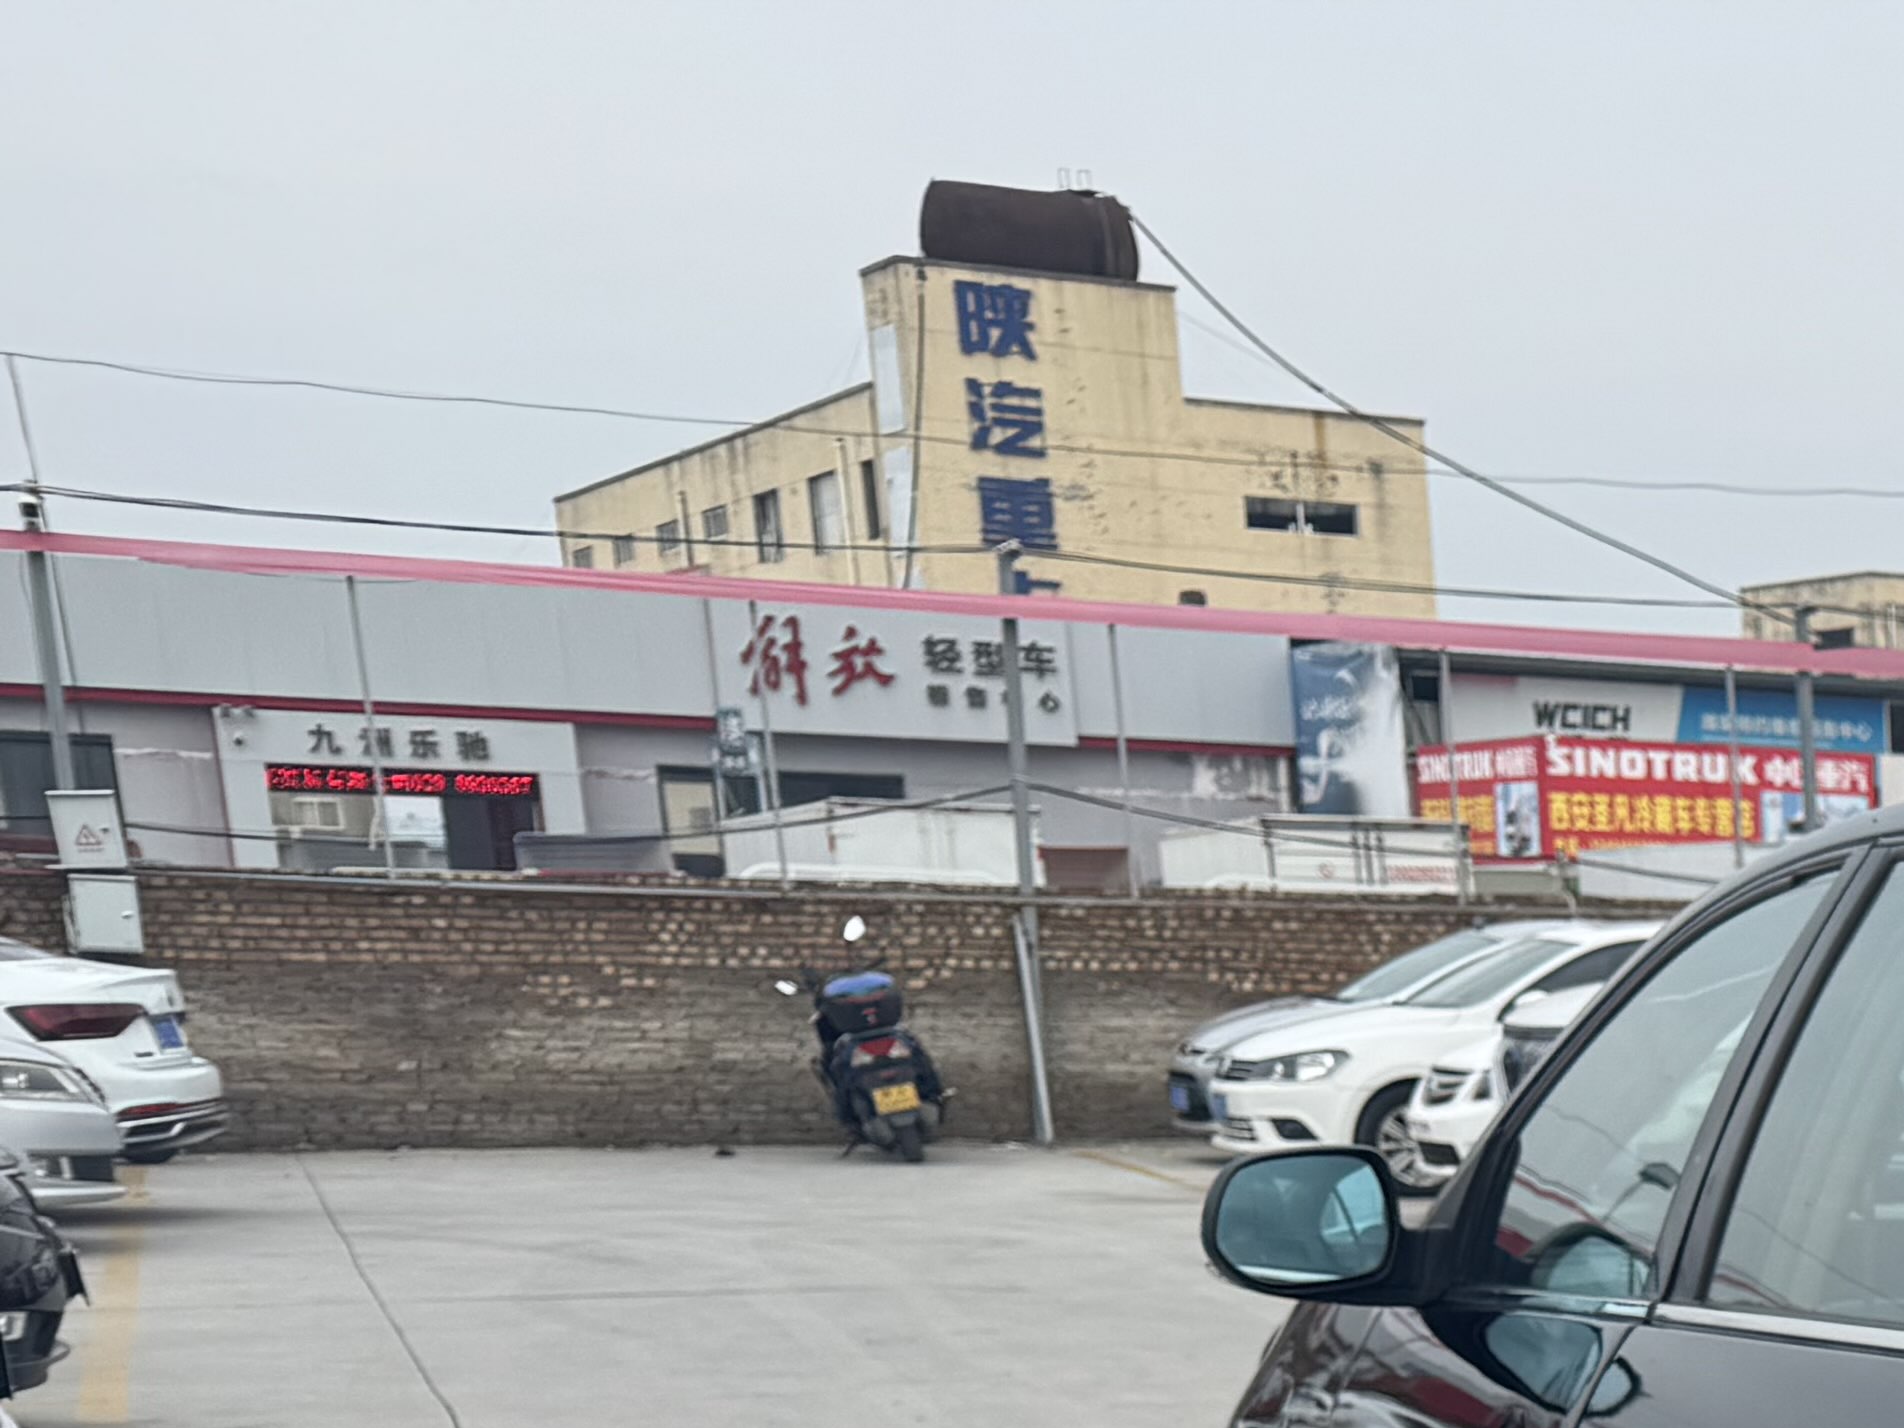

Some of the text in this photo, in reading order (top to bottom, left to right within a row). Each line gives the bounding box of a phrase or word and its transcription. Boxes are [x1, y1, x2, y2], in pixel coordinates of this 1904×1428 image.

[922, 634, 1058, 679] 轻型车
[1547, 737, 1760, 785] SINOTRUK
